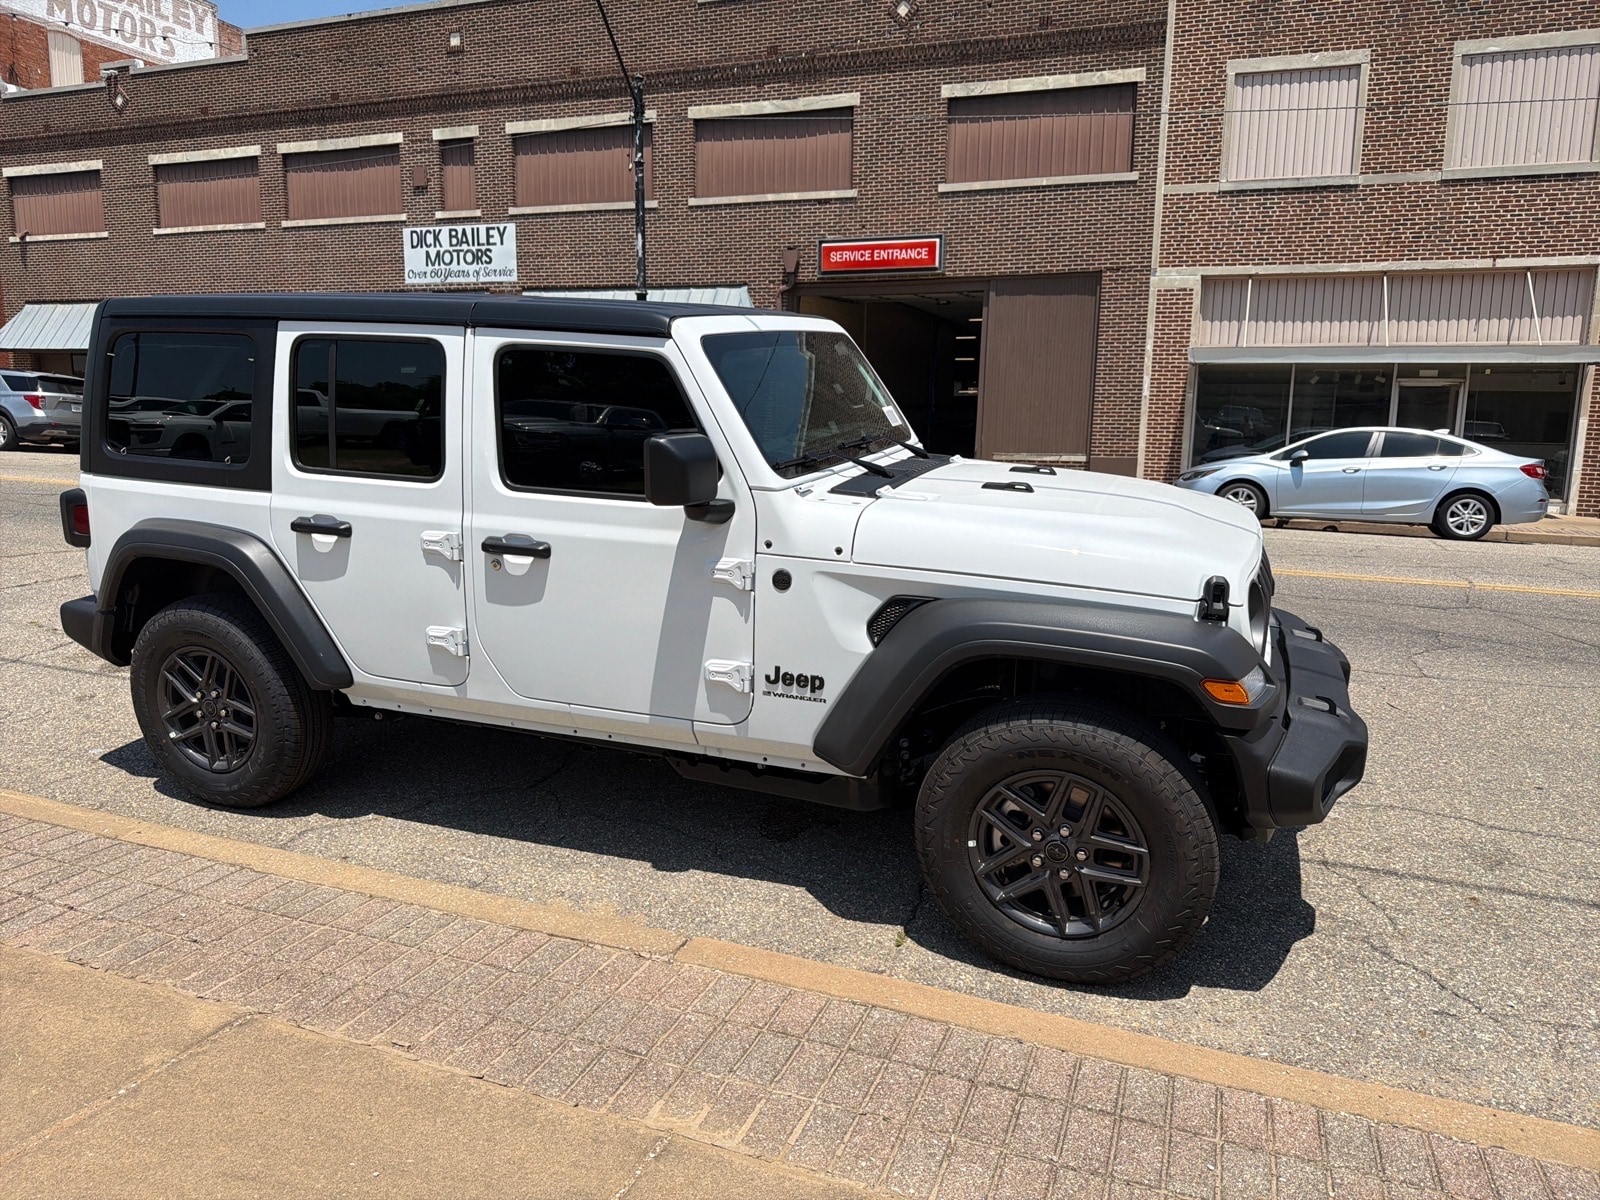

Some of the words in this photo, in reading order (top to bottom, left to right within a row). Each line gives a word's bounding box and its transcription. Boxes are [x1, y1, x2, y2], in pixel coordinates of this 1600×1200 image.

[108, 0, 209, 35] ILEY
[46, 0, 176, 58] MOTORS
[410, 229, 443, 249] DICK
[449, 226, 507, 247] BAILEY
[425, 248, 493, 267] MOTORS
[829, 250, 872, 263] SERVICE
[874, 248, 929, 260] ENTRANCE
[407, 269, 428, 280] Over
[429, 268, 443, 279] 60
[440, 268, 471, 283] Years
[472, 267, 482, 282] of
[482, 266, 515, 278] Service
[764, 665, 825, 693] Jeep
[772, 691, 827, 704] WRANGLER
